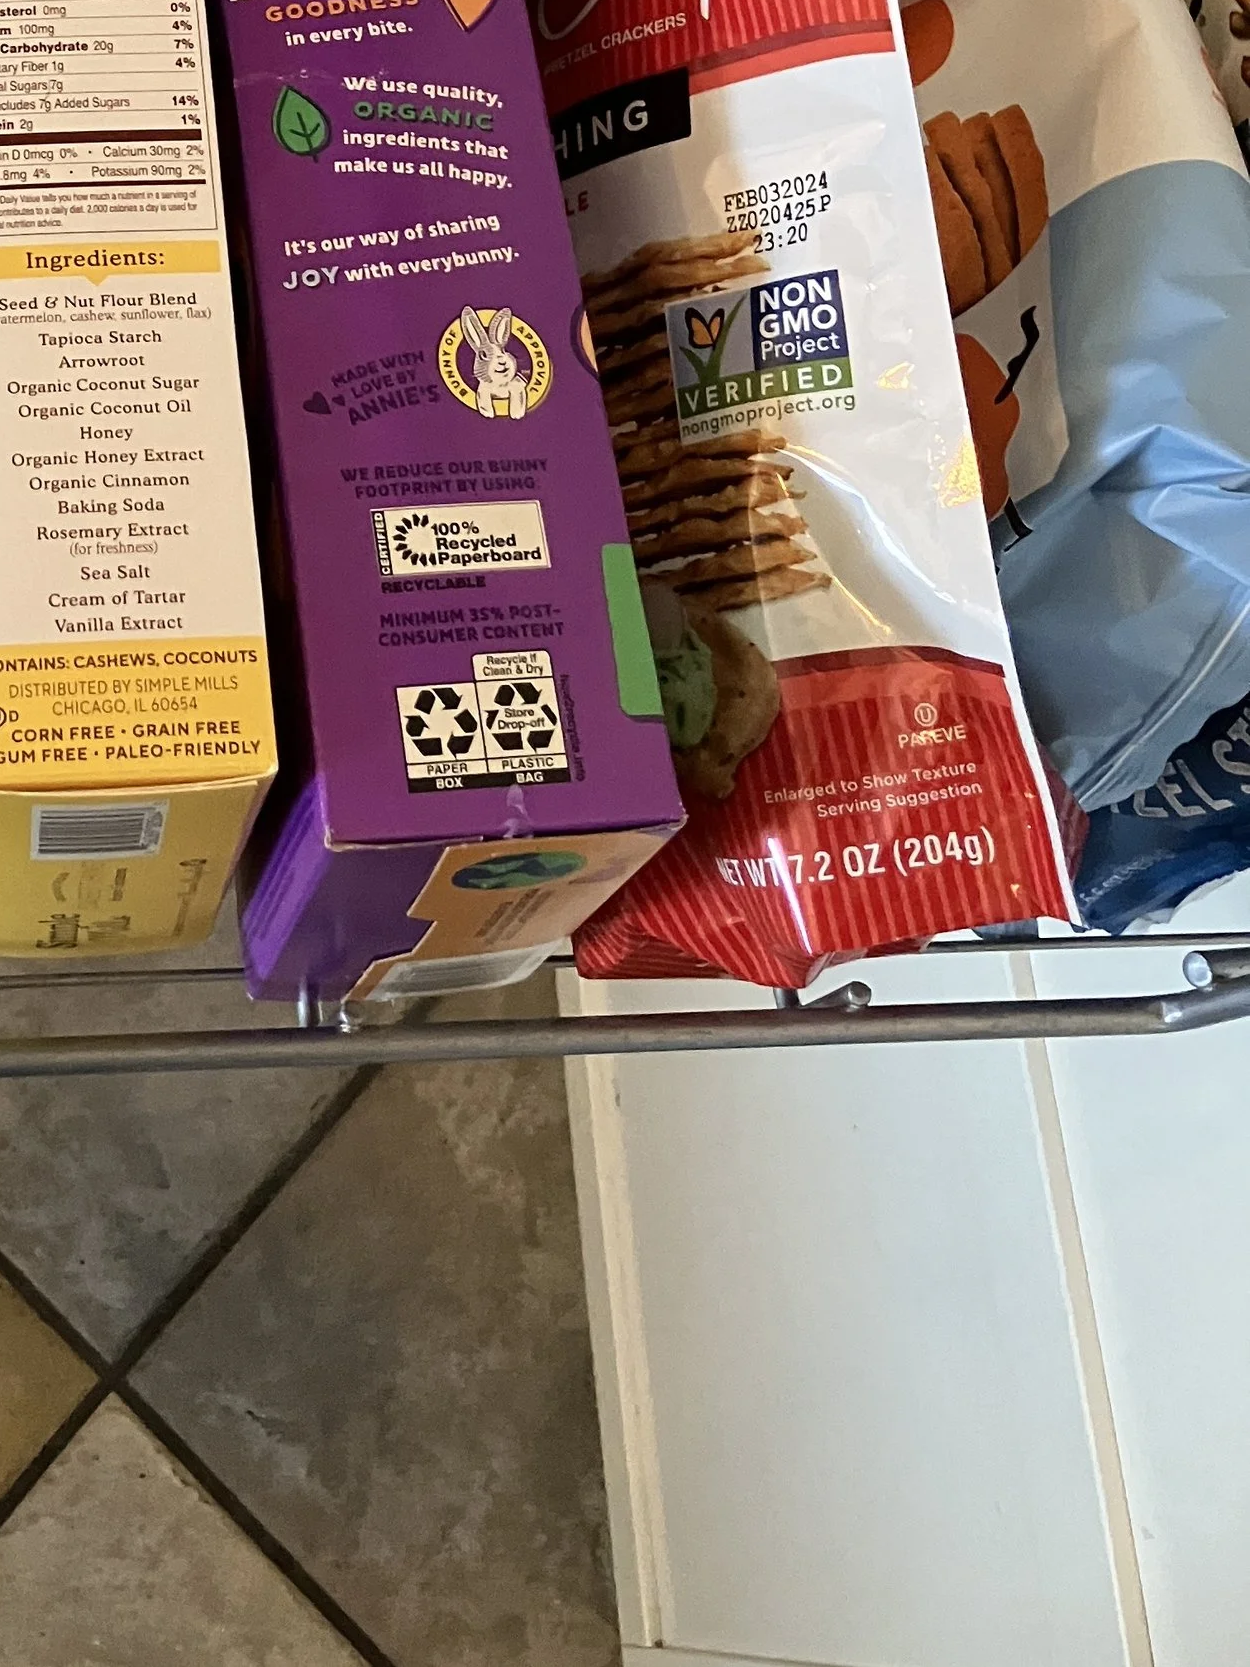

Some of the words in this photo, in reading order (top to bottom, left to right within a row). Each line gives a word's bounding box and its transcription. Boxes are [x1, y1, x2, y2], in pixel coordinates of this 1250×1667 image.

[600, 12, 687, 51] CRACKERS
[343, 76, 377, 91] We
[382, 80, 418, 93] use
[422, 80, 503, 108] quality,
[354, 101, 494, 131] ORGANIC
[343, 130, 460, 151] ingredients
[465, 140, 508, 159] that
[334, 158, 387, 172] make
[392, 160, 414, 173] us
[419, 161, 444, 177] all
[449, 164, 512, 188] happy.
[724, 171, 828, 212] FEB032024
[753, 224, 808, 253] 23:20
[26, 250, 166, 272] Ingredients:
[282, 266, 340, 290] JOY
[344, 262, 394, 282] with
[398, 245, 520, 274] everybunny.
[759, 276, 832, 313] NON
[759, 304, 837, 338] GMO
[446, 329, 456, 346] OF
[761, 333, 840, 362] Project
[331, 362, 379, 386] MADE
[384, 350, 425, 370] WITH
[439, 350, 468, 398] BUNNY
[516, 326, 546, 394] APPROVAL
[684, 364, 842, 413] VERIFIED
[348, 384, 440, 426] ANNIE'S
[681, 394, 856, 435] nongmoproject.org
[80, 426, 133, 441] Honey
[374, 513, 390, 574] CERTIFIED
[431, 521, 480, 536] 100%
[436, 534, 516, 550] Recycled
[438, 548, 542, 565] Paperboard
[42, 747, 88, 762] FREE
[105, 741, 260, 760] PALEO-FRIENDLY
[898, 725, 967, 749] PAREVE
[427, 763, 468, 774] PAPER
[502, 758, 554, 770] PLASTIC
[436, 777, 464, 788] BOX
[516, 772, 544, 783] BAG
[763, 782, 836, 804] Enlarged
[840, 779, 858, 794] to
[863, 772, 907, 790] Show
[912, 761, 976, 783] Texture
[817, 796, 882, 818] Serving
[886, 781, 982, 809] Suggestion
[716, 857, 744, 886] NET
[794, 854, 834, 884] 7.2
[843, 843, 886, 877] OZ
[893, 825, 994, 876] (204g)
